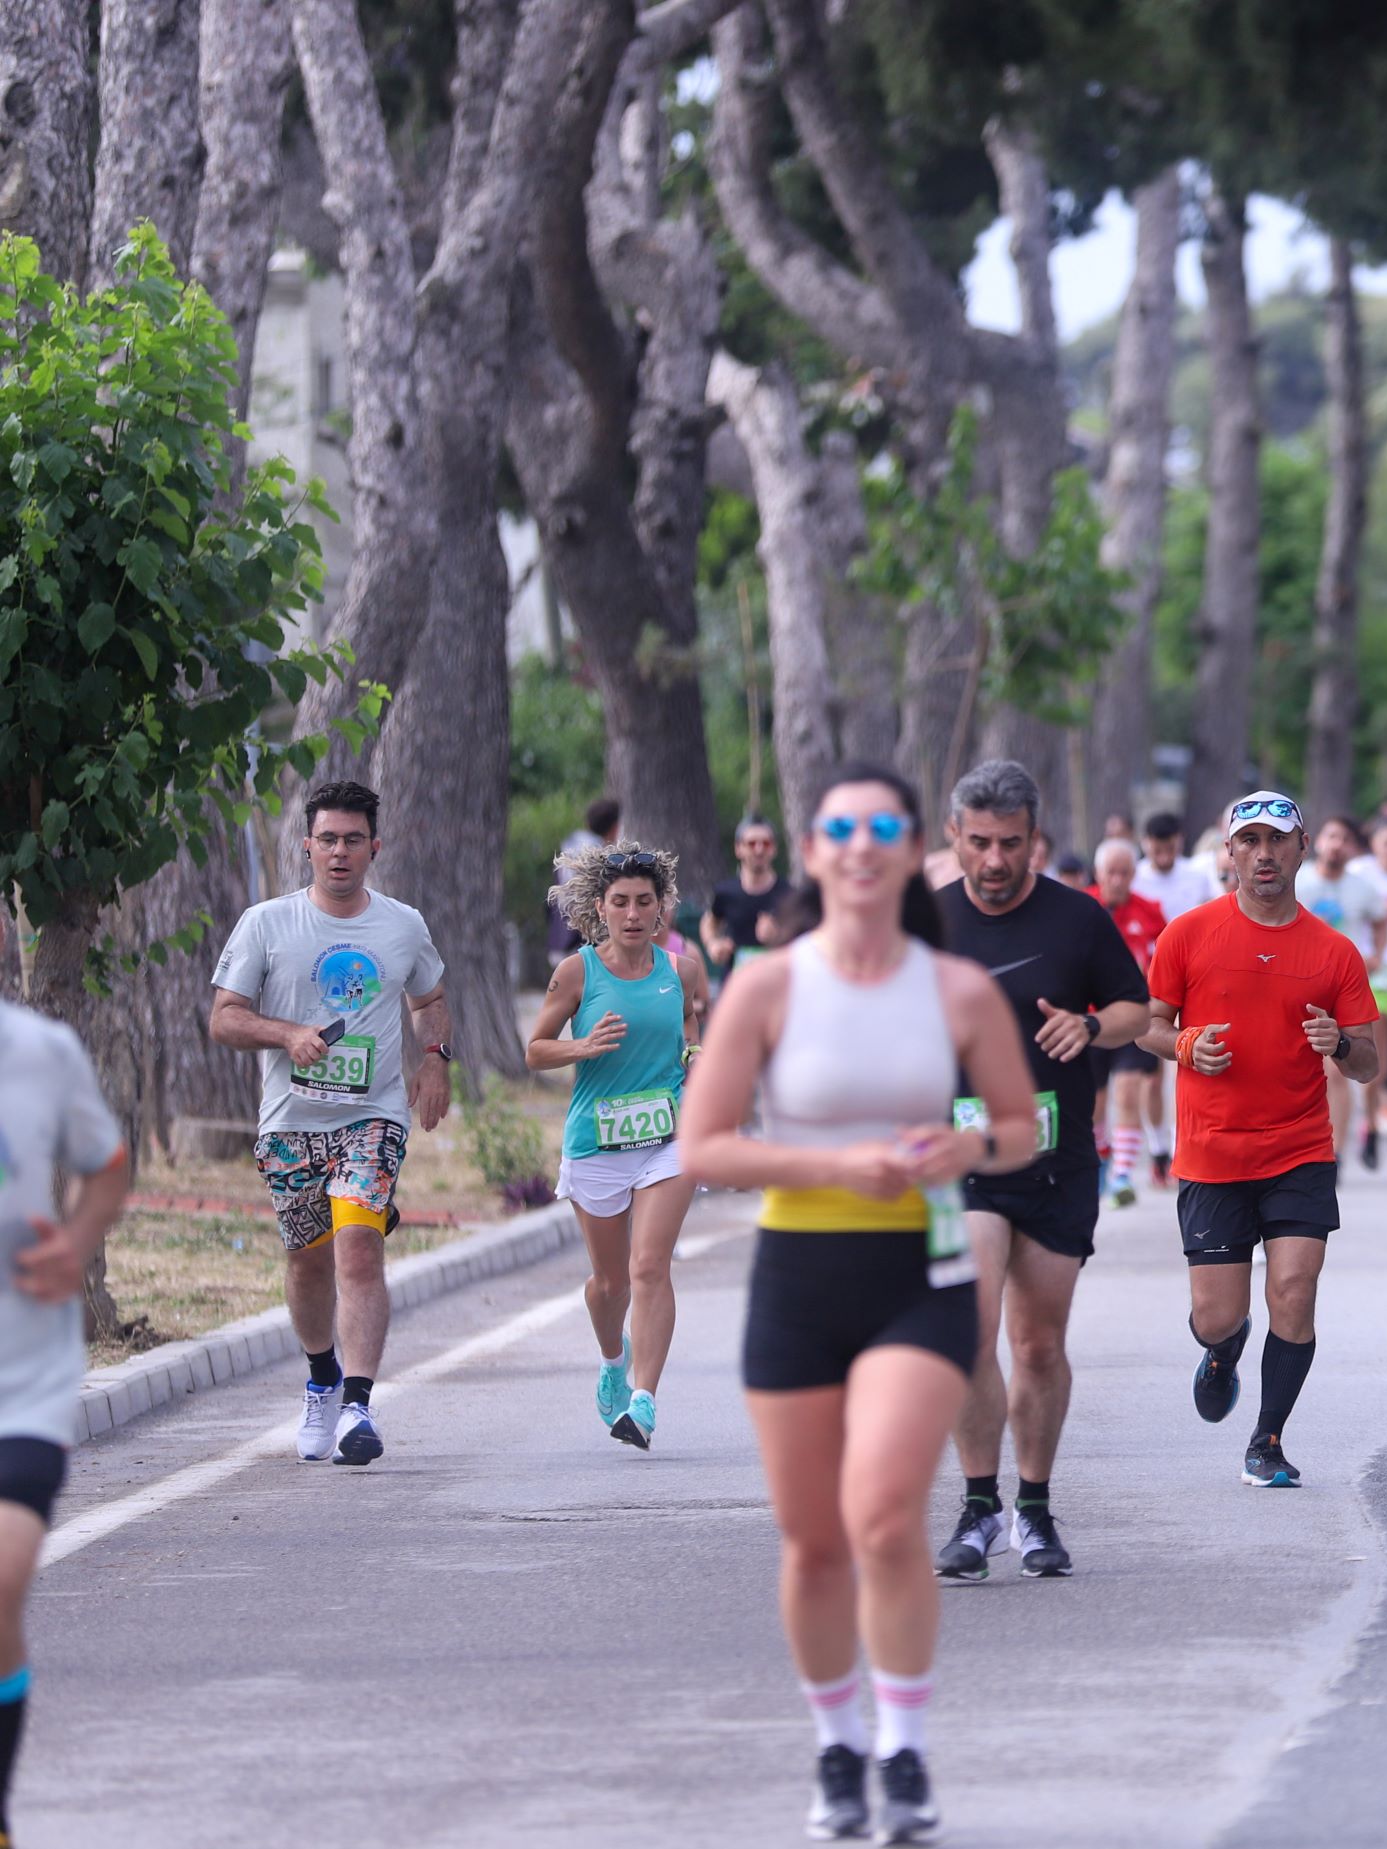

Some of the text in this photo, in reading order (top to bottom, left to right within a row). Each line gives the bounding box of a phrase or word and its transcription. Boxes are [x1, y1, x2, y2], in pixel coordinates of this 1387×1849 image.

[308, 1080, 351, 1092] SALOMON
[601, 1109, 670, 1142] 7420
[620, 1138, 662, 1150] SALOMON
